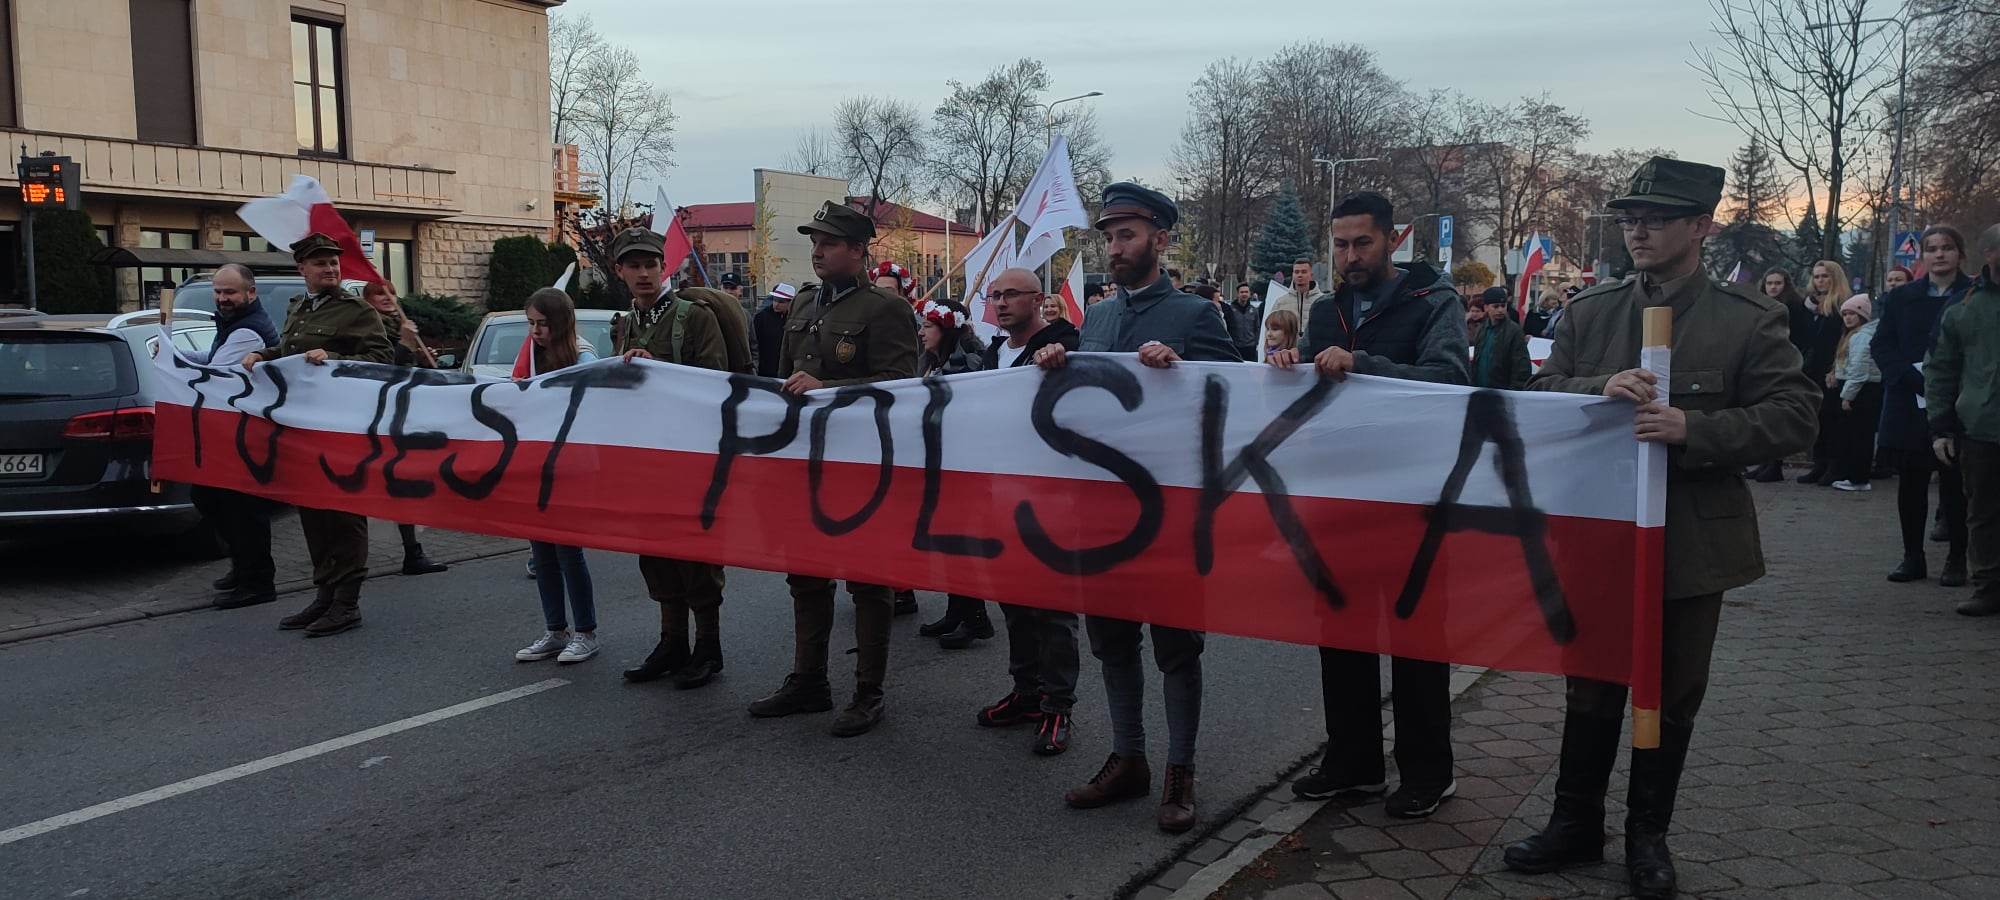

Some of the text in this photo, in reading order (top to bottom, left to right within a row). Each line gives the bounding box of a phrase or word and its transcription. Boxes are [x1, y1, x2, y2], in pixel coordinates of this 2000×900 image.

[1442, 219, 1450, 238] P
[0, 455, 39, 472] 664
[173, 354, 1577, 645] TO JEST POLSKA
